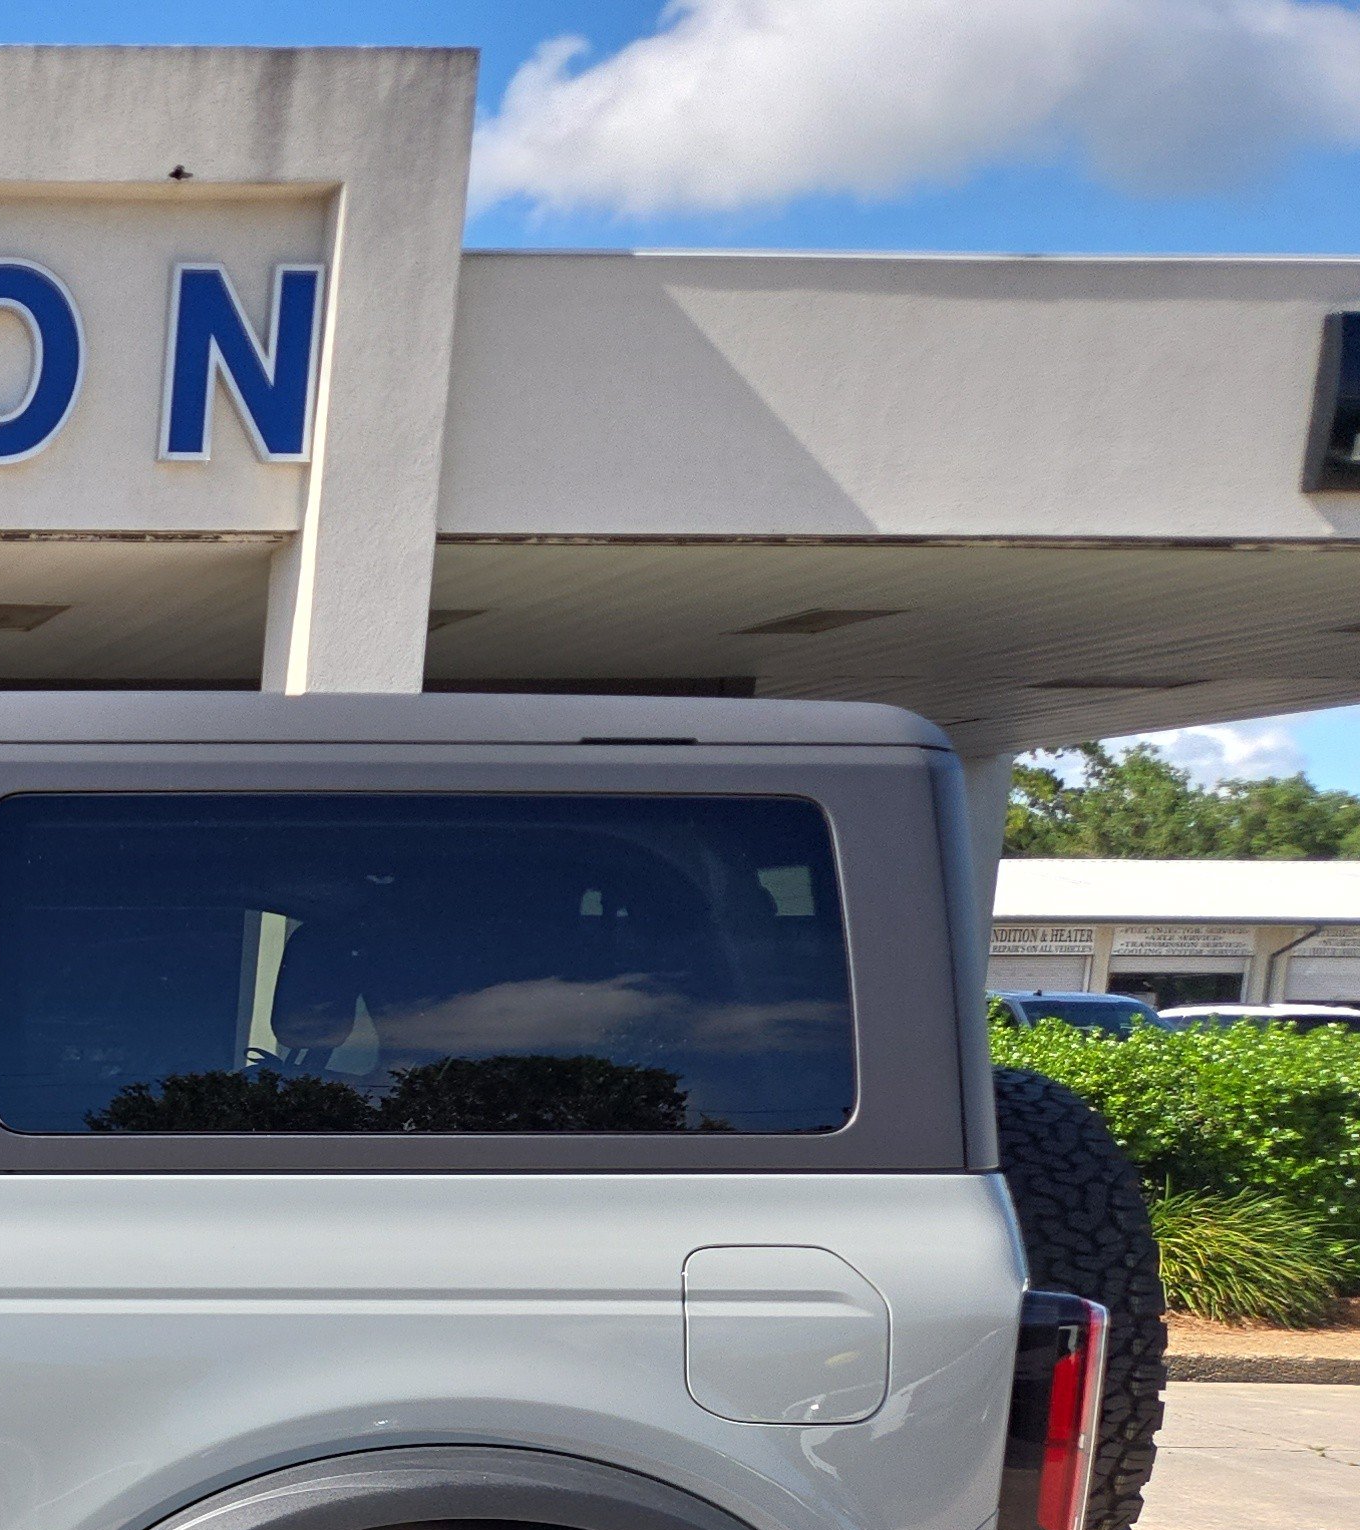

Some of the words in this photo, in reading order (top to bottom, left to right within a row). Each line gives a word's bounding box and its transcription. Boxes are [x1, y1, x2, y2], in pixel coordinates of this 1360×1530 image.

[1040, 928, 1048, 943] &
[1050, 928, 1093, 943] HEATER
[1026, 944, 1038, 953] ON
[1039, 944, 1053, 953] ALL
